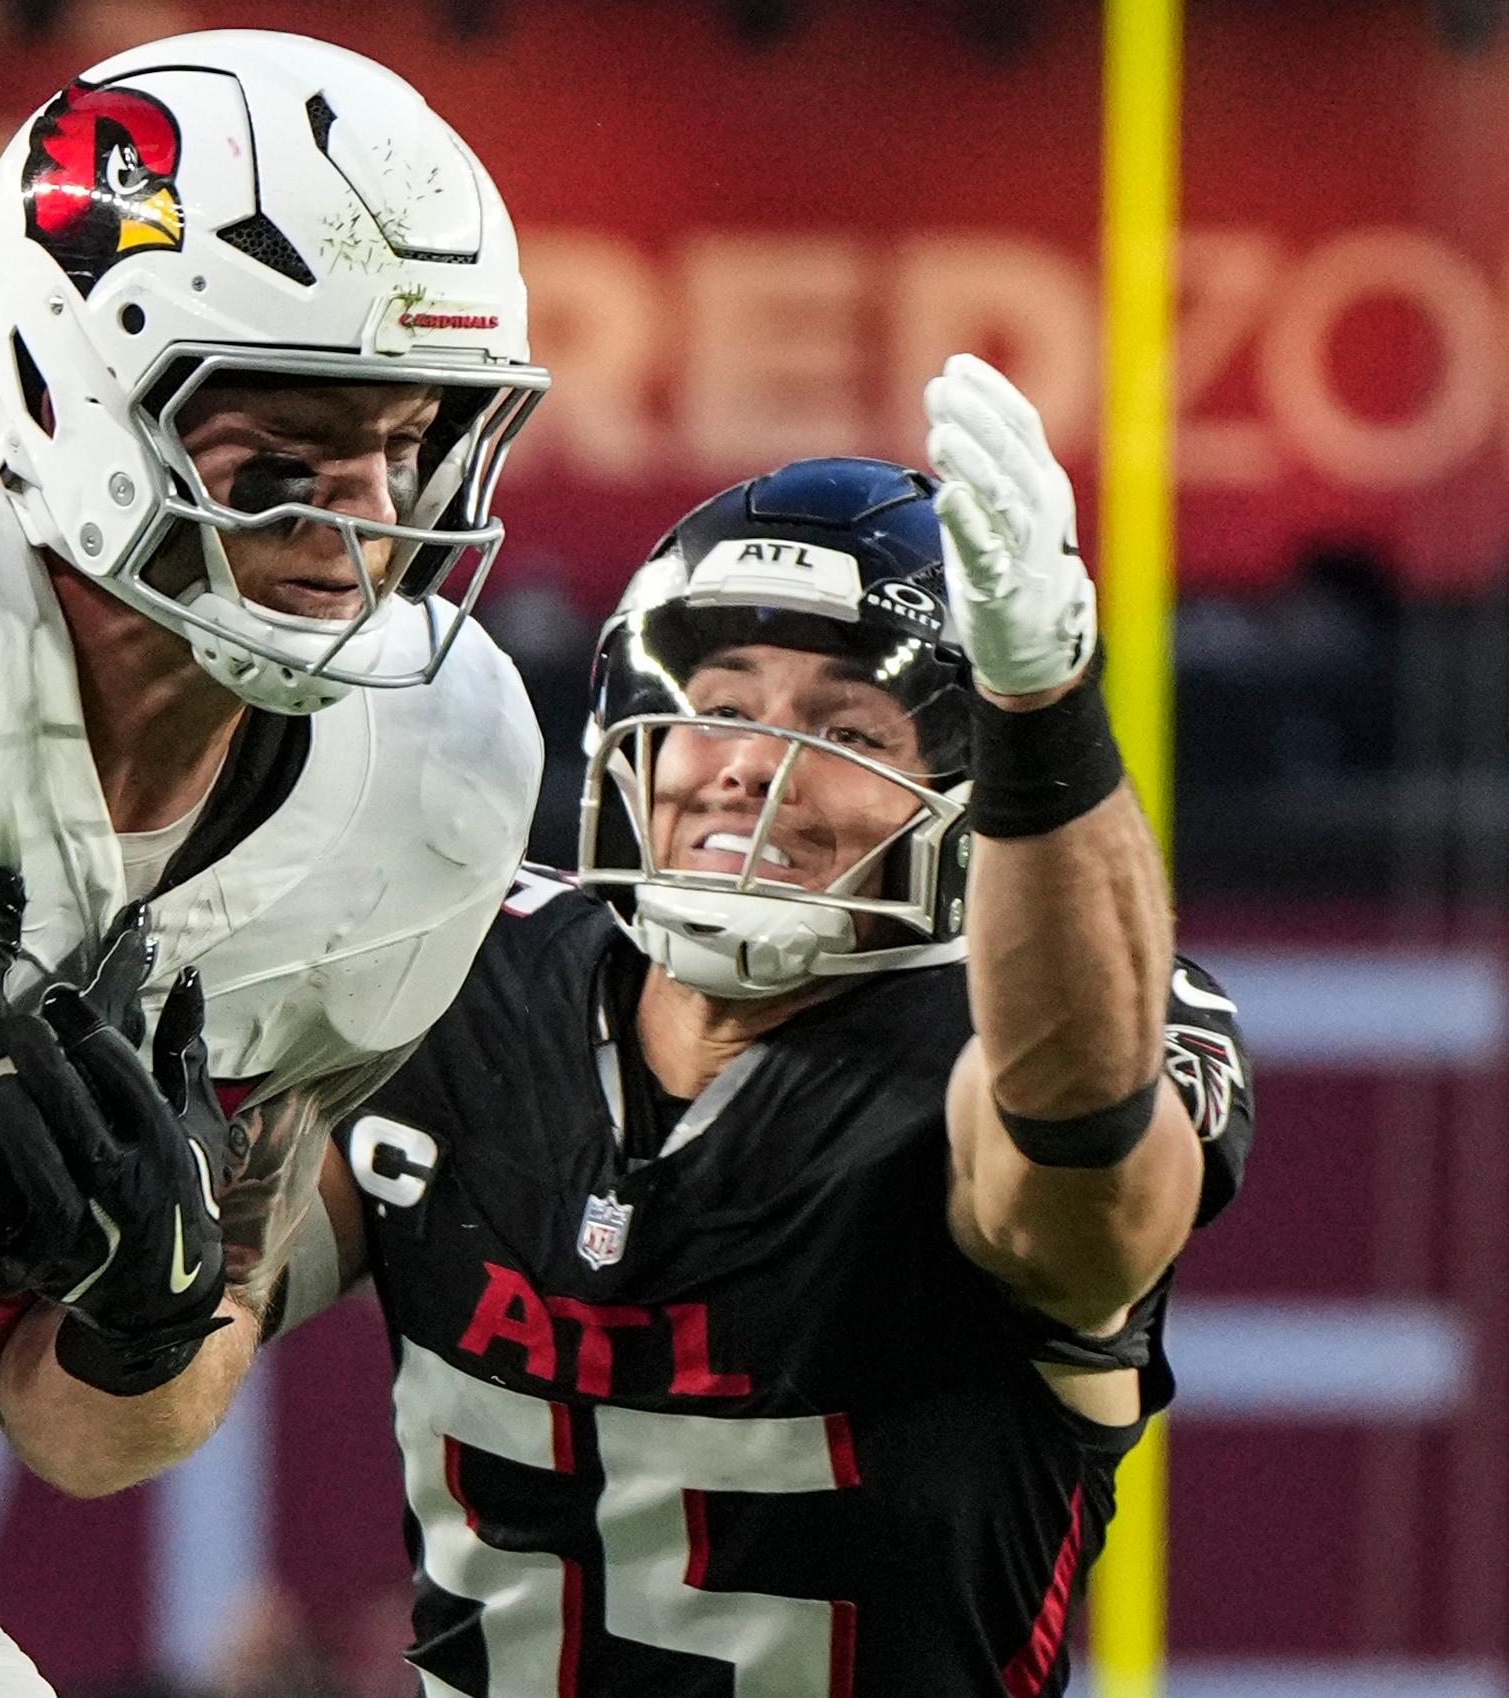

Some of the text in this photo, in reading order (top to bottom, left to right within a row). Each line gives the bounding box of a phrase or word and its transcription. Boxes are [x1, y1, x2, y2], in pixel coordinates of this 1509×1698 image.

[399, 312, 499, 329] CARDINALS
[511, 226, 1509, 492] REDZO
[737, 543, 813, 568] ATL
[867, 593, 941, 630] OAKLEY
[349, 1114, 439, 1209] C
[457, 1261, 753, 1398] ATL
[392, 1333, 861, 1698] 55
